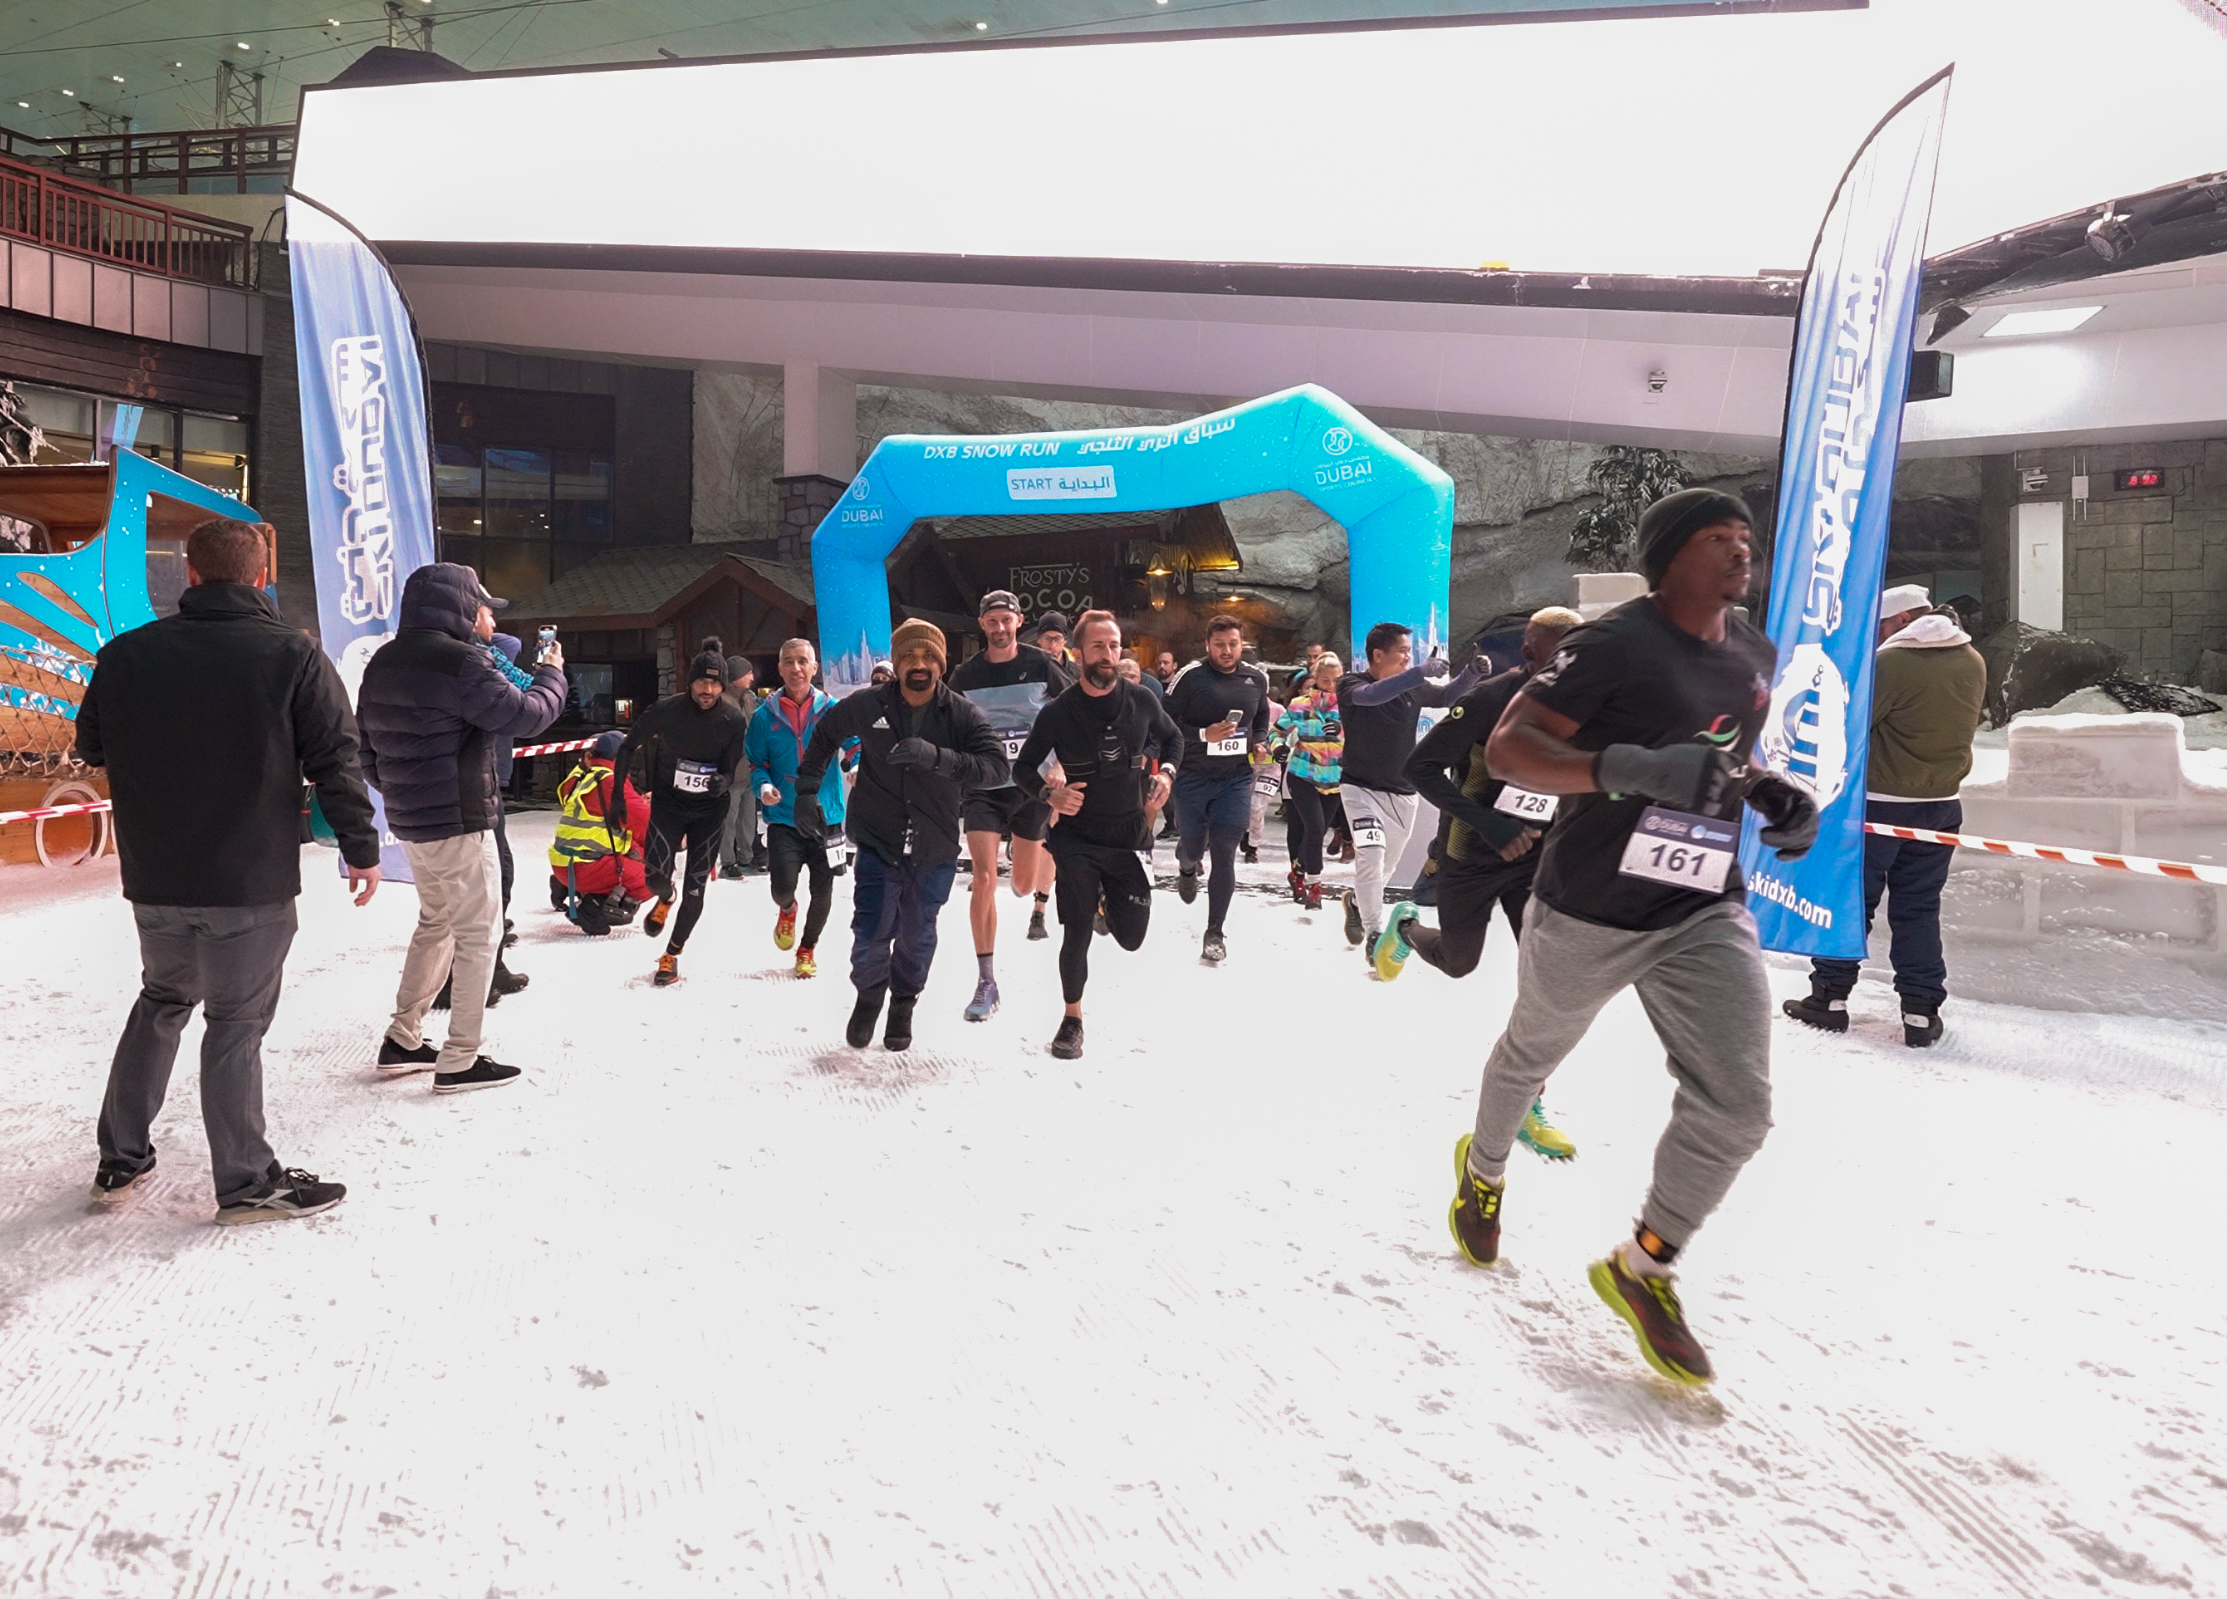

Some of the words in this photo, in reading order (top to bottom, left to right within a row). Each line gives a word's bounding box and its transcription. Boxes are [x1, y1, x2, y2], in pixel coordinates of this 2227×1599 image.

[1821, 271, 1863, 492] DUBAI
[1183, 417, 1236, 445] سباق
[924, 446, 957, 459] DXB
[961, 443, 1017, 459] SNOW
[1019, 442, 1061, 457] RUN
[1011, 477, 1053, 490] START
[1314, 460, 1372, 485] DUBAI
[1058, 476, 1111, 492] البداية
[841, 508, 884, 522] DUBAI
[1008, 562, 1090, 592] FROSTY'S
[1018, 588, 1094, 613] OCOA
[1217, 741, 1239, 751] 160
[685, 775, 710, 788] 156
[1515, 794, 1548, 813] 128
[1650, 843, 1708, 876] 161
[1747, 871, 1832, 930] skidxb.com
